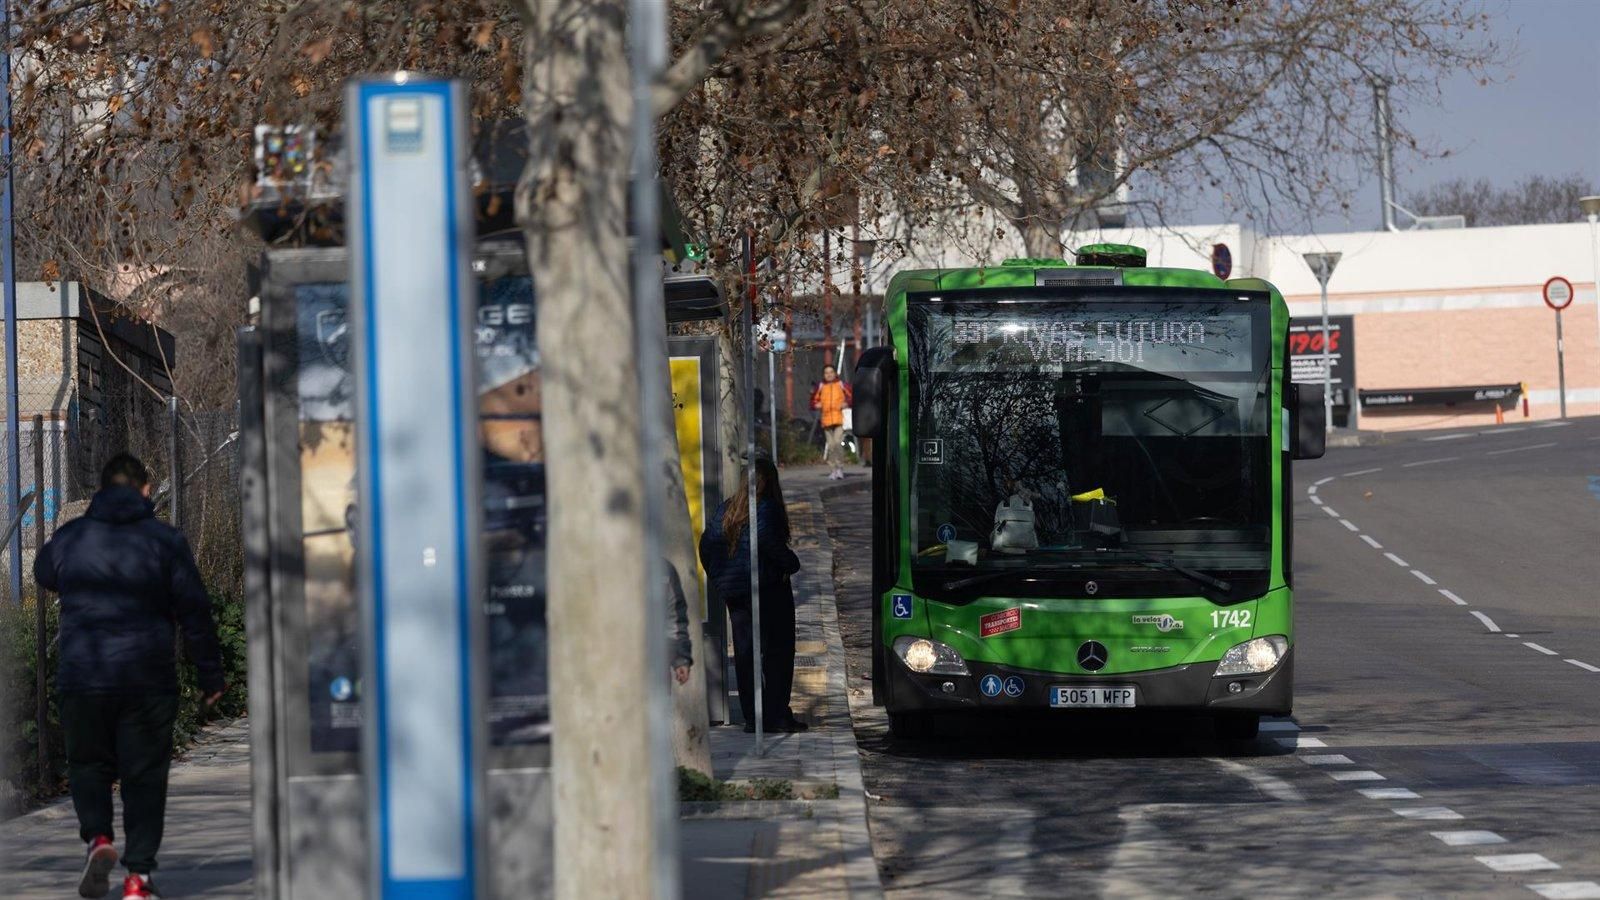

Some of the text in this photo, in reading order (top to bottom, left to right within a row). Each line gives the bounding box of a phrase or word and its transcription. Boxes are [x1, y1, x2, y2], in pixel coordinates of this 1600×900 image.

[955, 321, 989, 344] 331
[1097, 321, 1205, 344] FUTURA
[1210, 609, 1251, 628] 1742
[1060, 690, 1097, 704] 5051
[1103, 690, 1131, 704] MFP
